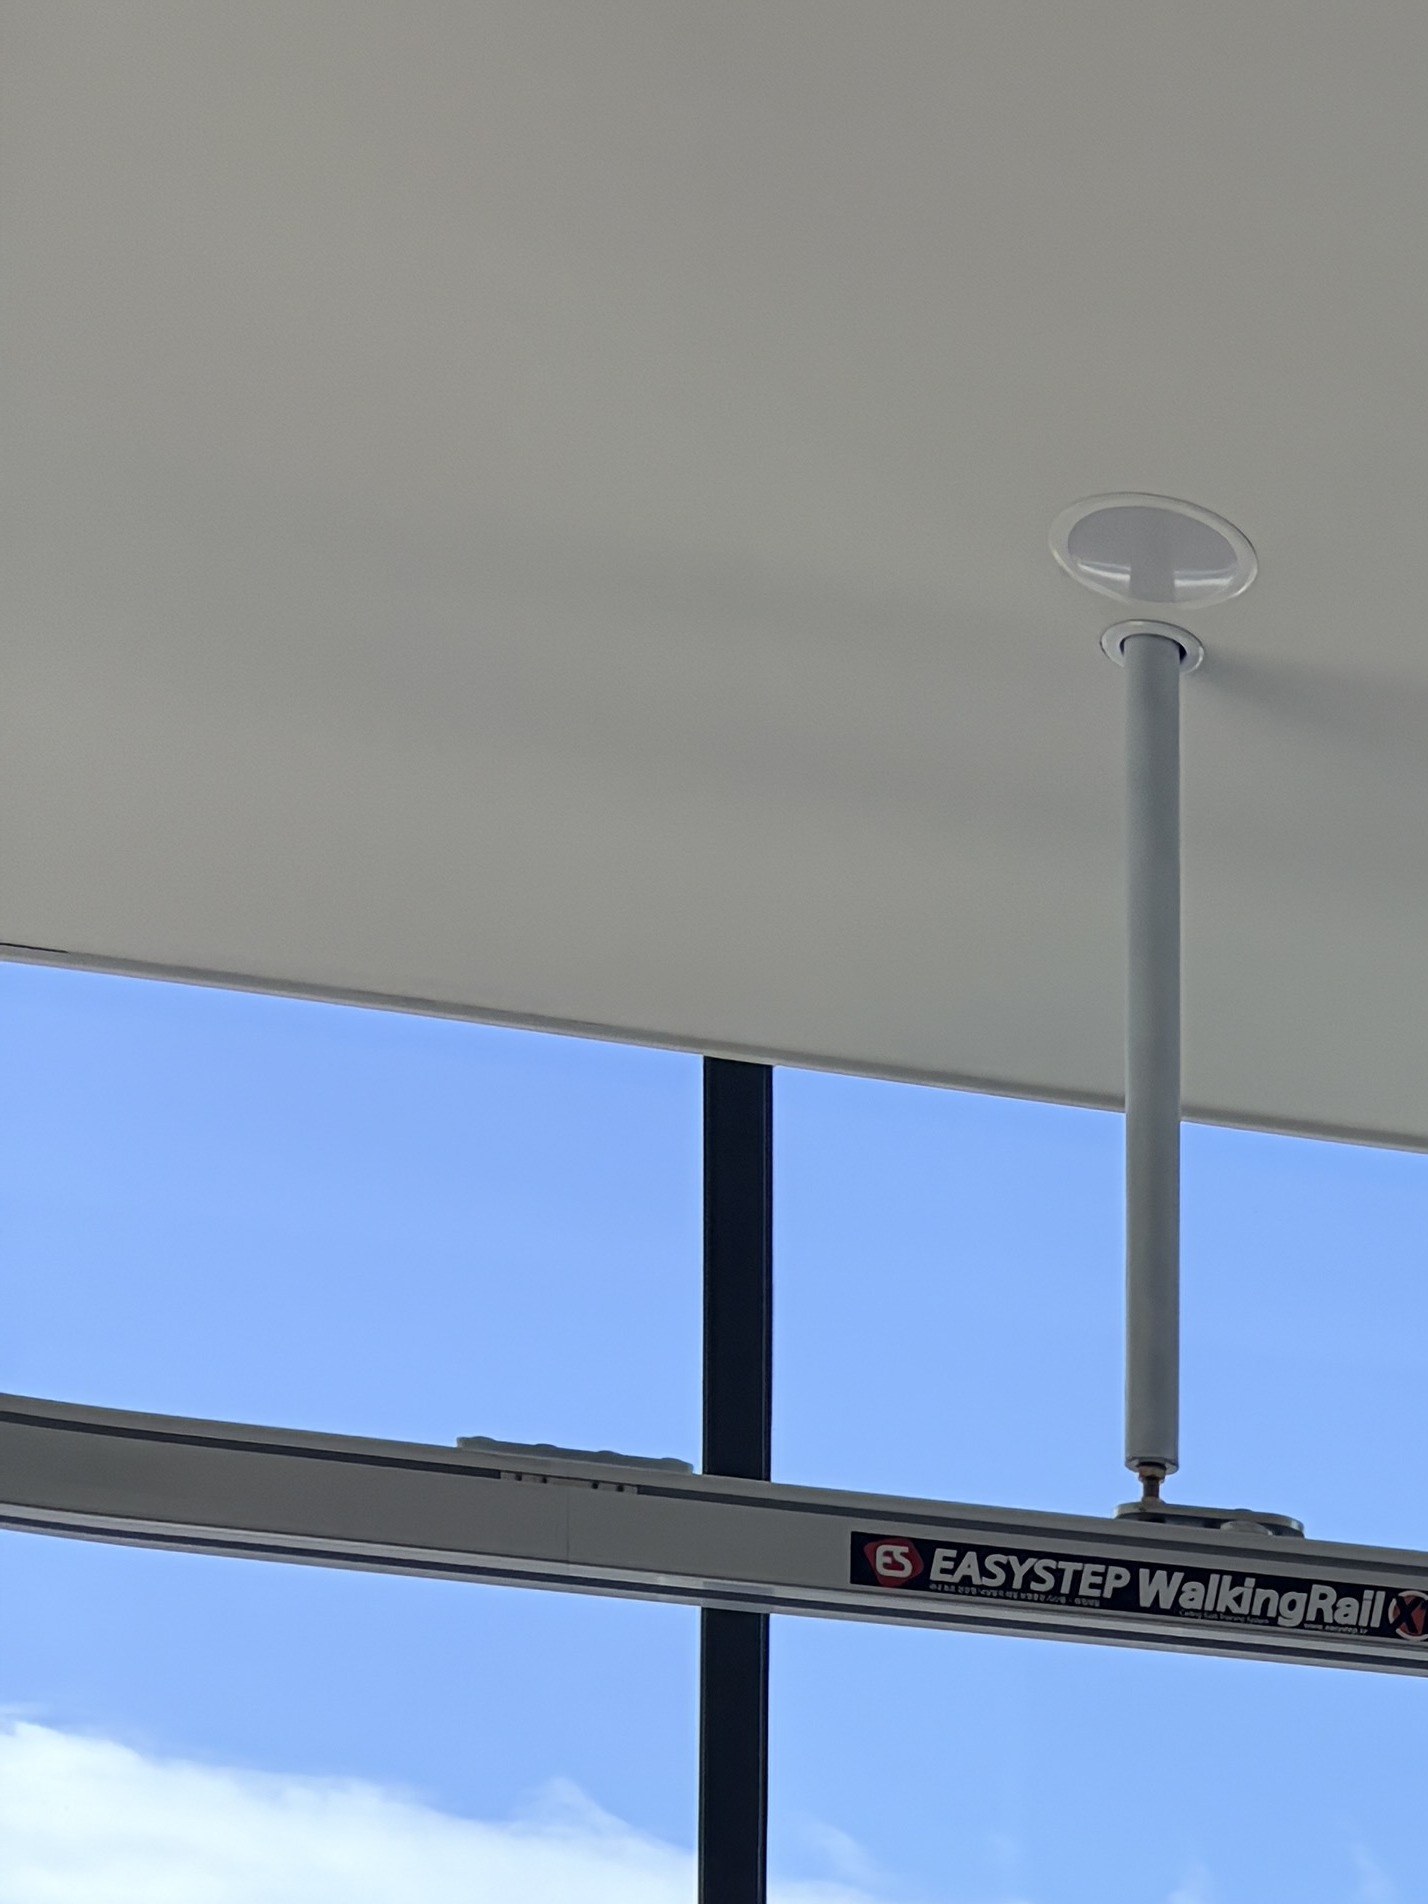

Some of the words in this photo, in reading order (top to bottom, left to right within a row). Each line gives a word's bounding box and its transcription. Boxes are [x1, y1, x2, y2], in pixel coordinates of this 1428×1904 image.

[875, 1544, 913, 1579] ES
[930, 1547, 1131, 1599] EASYSTEP
[1139, 1568, 1387, 1628] WalkingRail
